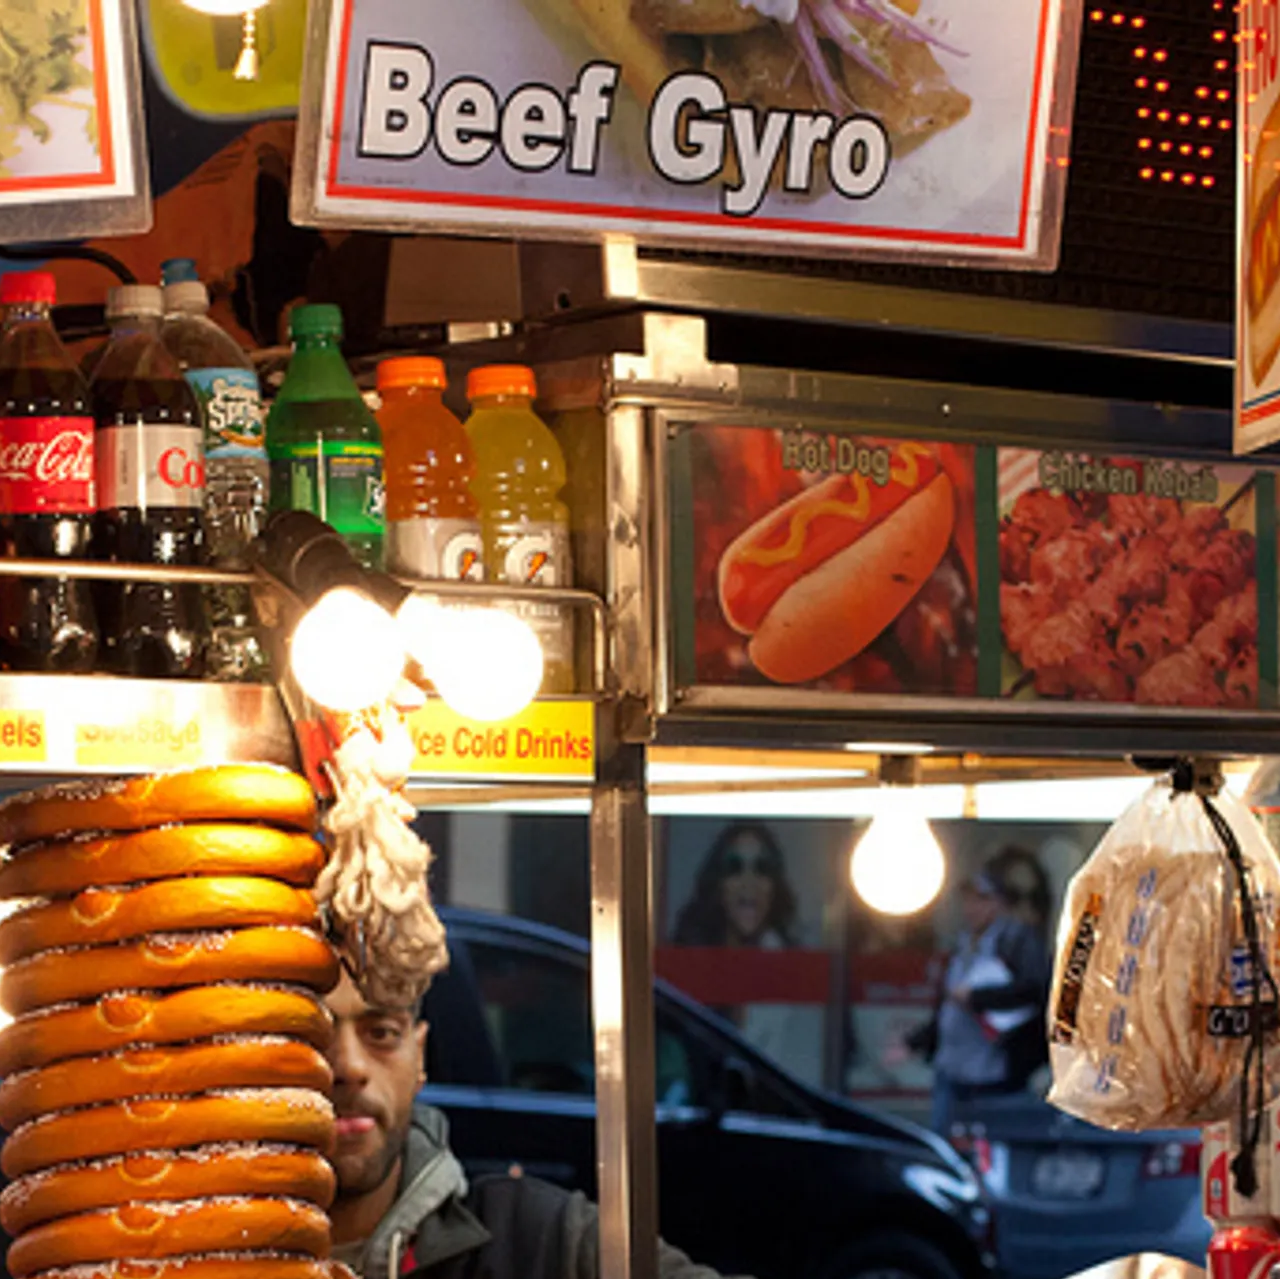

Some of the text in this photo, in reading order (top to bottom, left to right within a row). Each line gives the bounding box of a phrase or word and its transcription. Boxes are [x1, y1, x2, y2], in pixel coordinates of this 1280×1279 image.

[357, 40, 891, 218] Beef Gyro
[782, 437, 889, 486] Hot Dog
[1039, 450, 1218, 502] Chicken Kebab
[453, 727, 507, 759] Cold
[516, 727, 592, 760] Drinks
